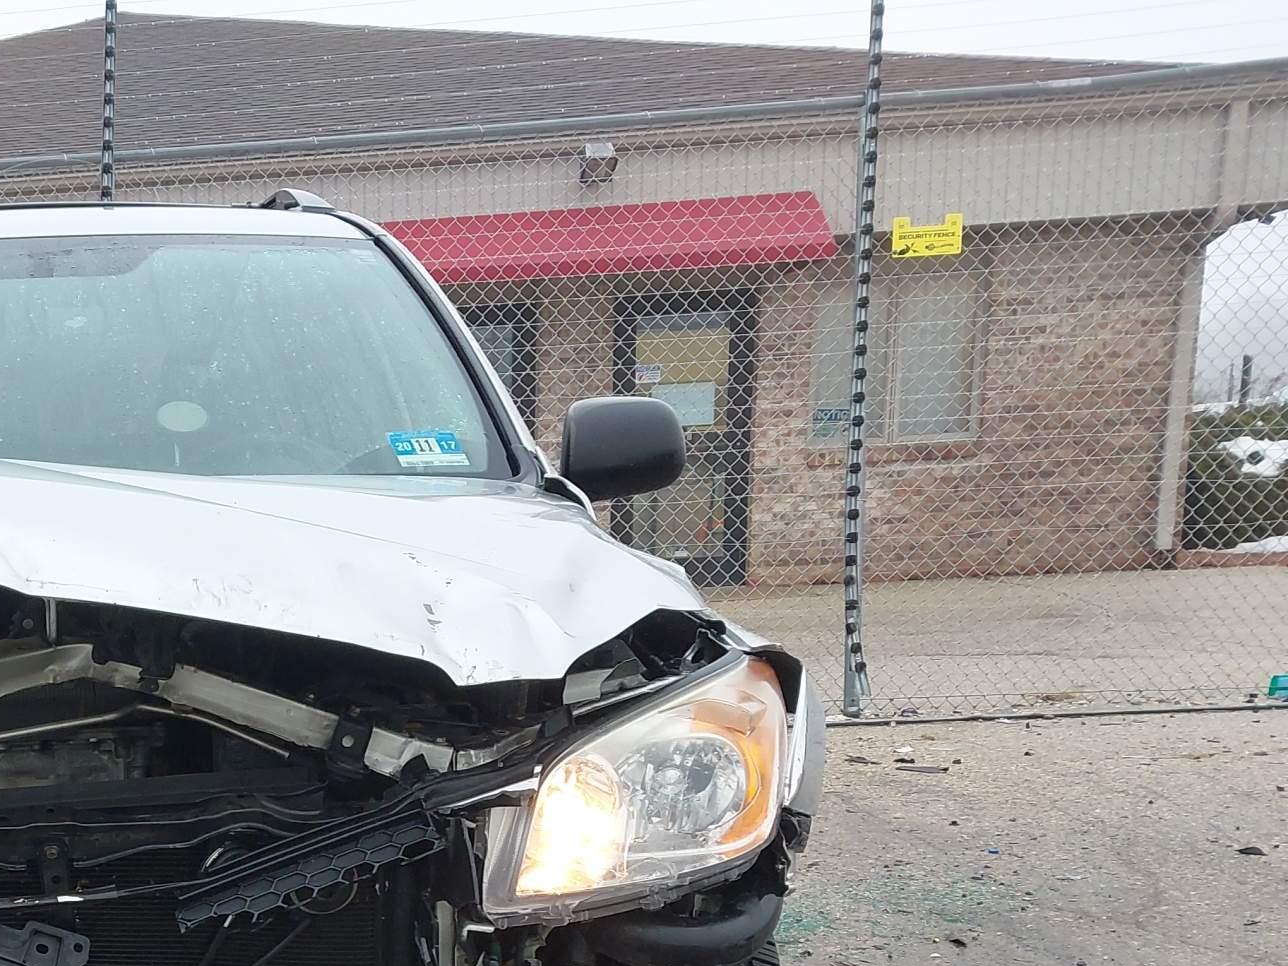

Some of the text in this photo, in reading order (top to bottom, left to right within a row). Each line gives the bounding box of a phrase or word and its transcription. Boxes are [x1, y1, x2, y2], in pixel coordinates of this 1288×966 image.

[814, 410, 850, 420] NOTIC
[395, 439, 456, 453] 20 11 17
